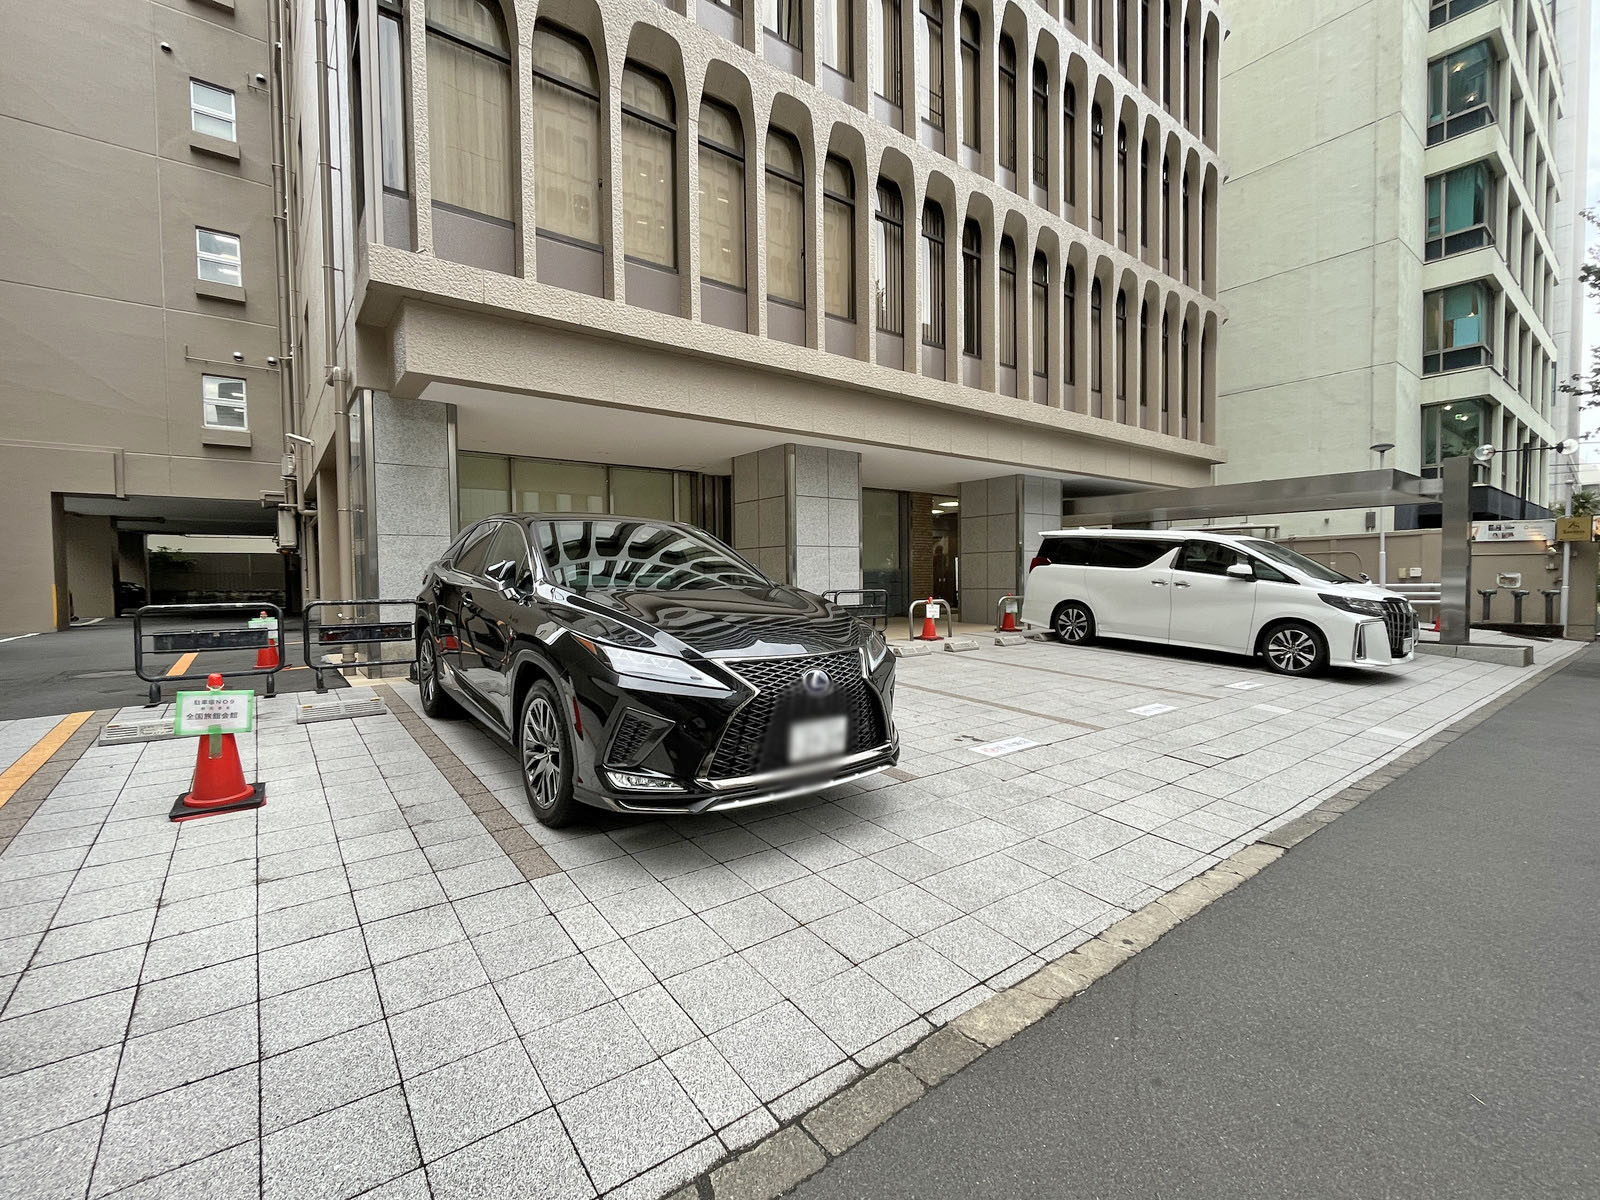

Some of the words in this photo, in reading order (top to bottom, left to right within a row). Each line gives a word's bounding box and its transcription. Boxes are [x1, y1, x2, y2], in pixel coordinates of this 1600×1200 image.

[186, 712, 238, 720] 全国旅館会館
